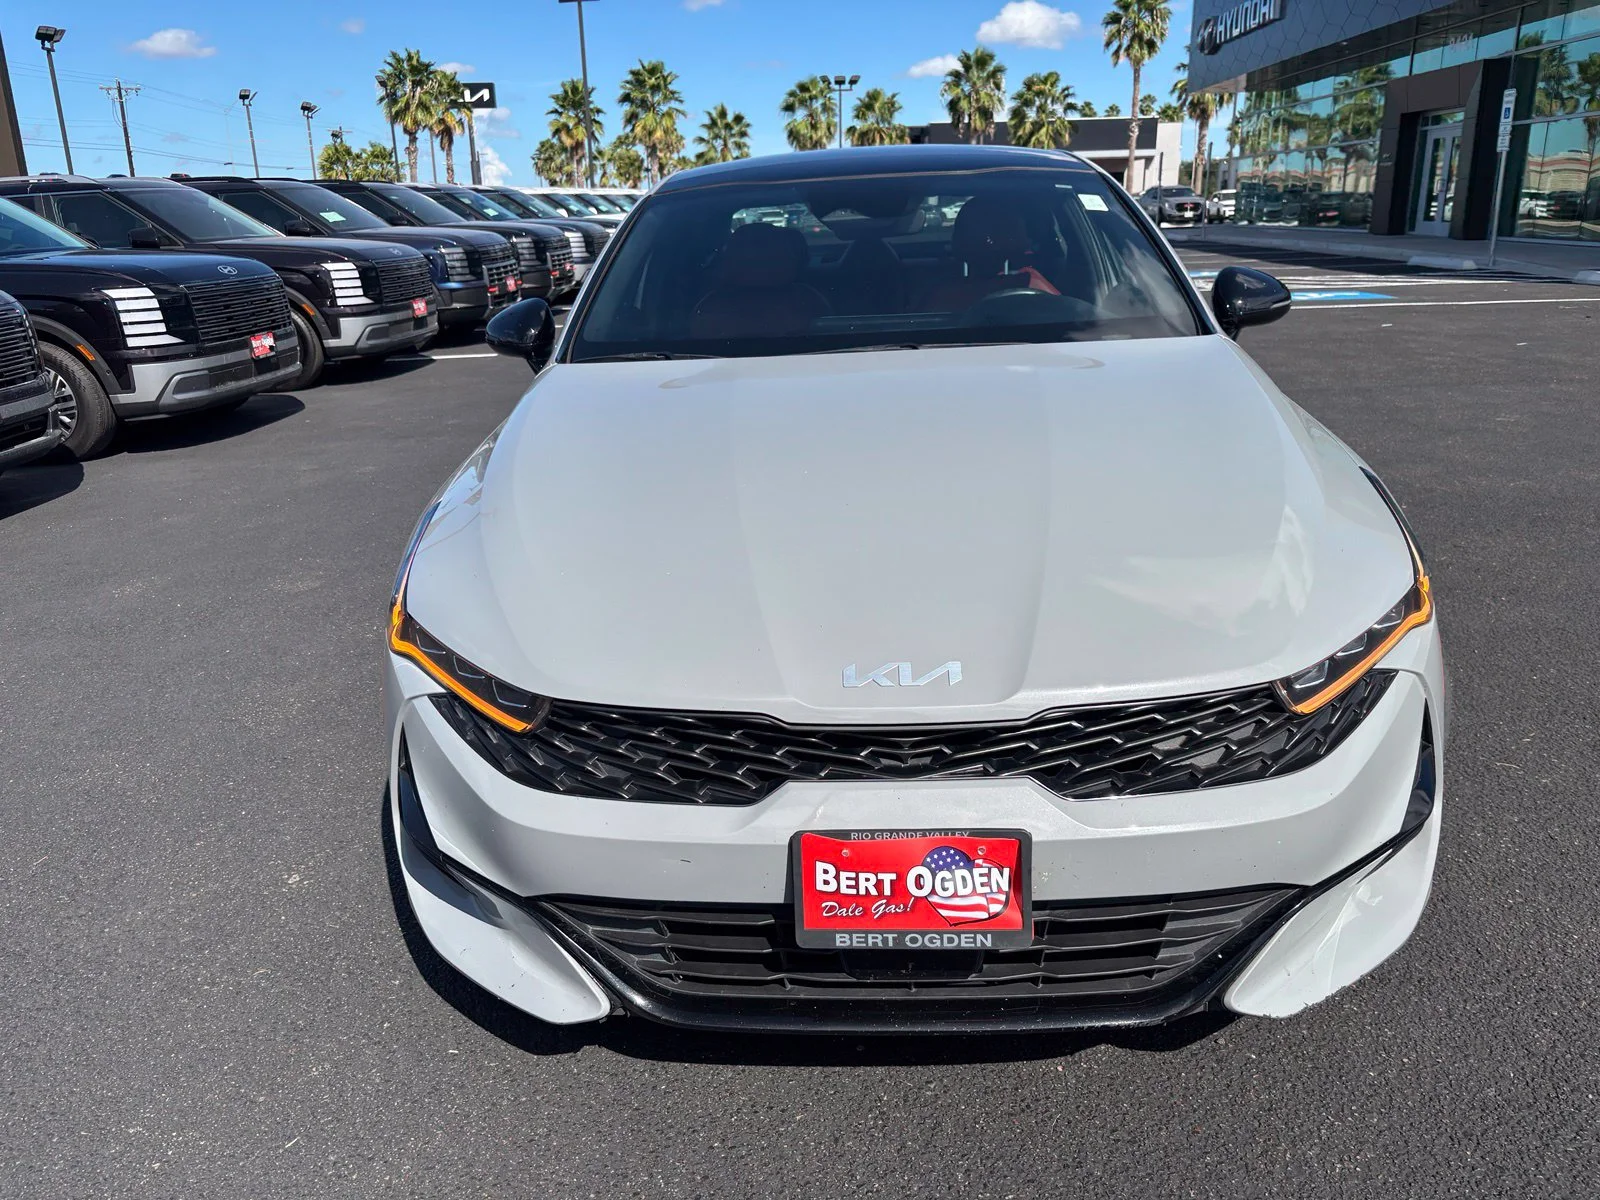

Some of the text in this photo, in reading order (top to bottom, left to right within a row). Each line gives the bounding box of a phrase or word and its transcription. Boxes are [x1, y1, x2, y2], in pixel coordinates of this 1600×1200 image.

[1216, 0, 1275, 44] HYUNDAI
[842, 661, 963, 688] KIA
[851, 832, 872, 840] RIO
[874, 831, 923, 840] GRANDE
[815, 860, 1011, 898] BERT OGDEN
[821, 896, 915, 919] Dale Gas!
[835, 933, 992, 947] BERT OGDEN
